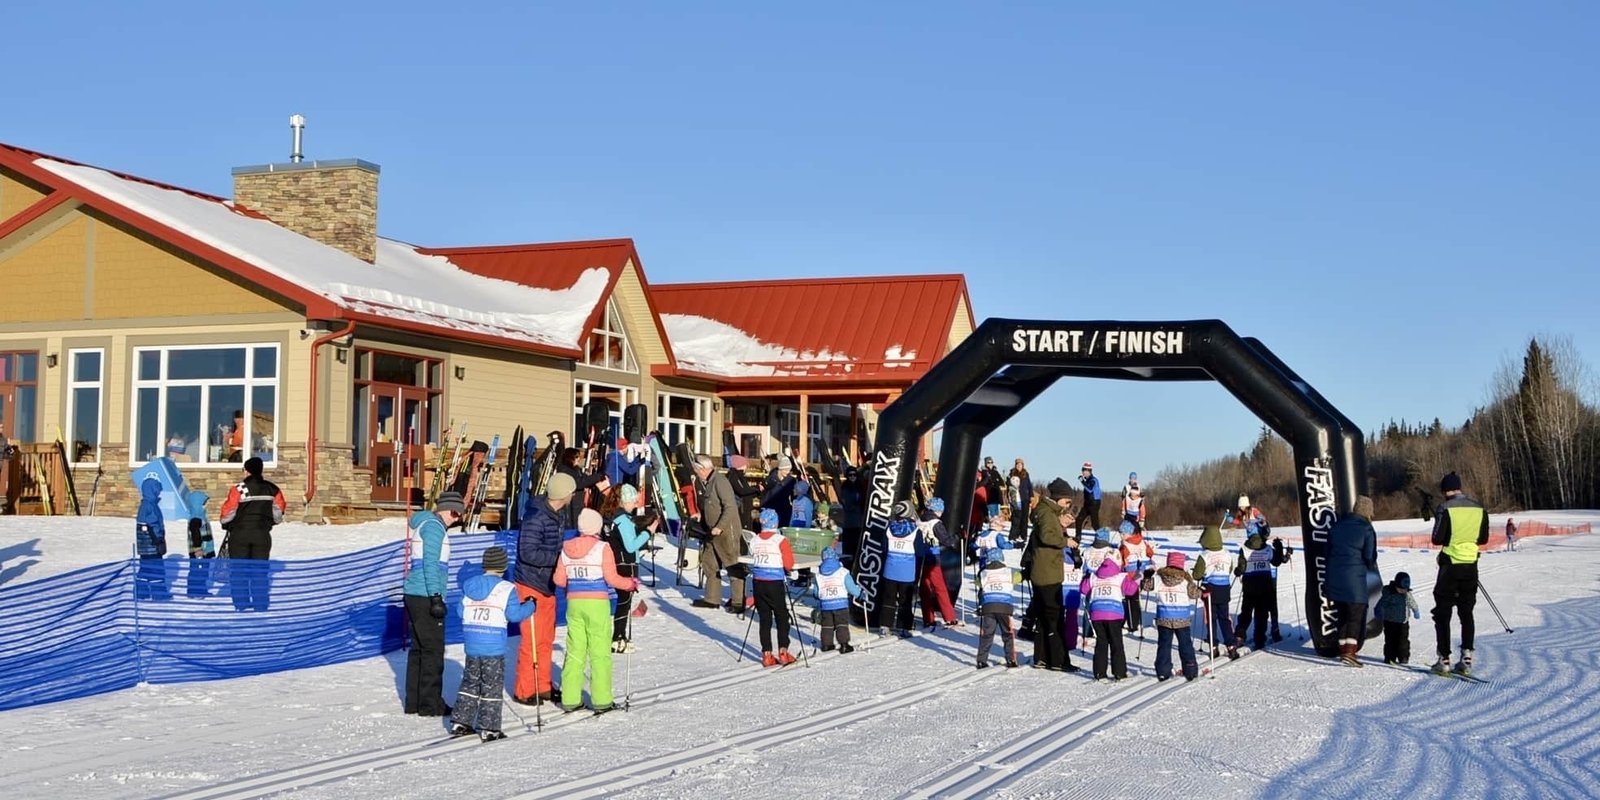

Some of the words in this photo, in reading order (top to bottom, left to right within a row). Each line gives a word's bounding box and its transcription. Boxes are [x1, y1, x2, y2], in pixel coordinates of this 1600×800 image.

[1012, 329, 1084, 352] START
[1088, 330, 1099, 355] /
[1105, 331, 1184, 354] FINISH
[866, 450, 900, 530] TRAX
[893, 541, 906, 550] 167
[756, 553, 769, 565] 172
[573, 566, 588, 578] 161
[853, 531, 882, 612] FAST
[1066, 573, 1079, 582] 152
[990, 582, 1004, 592] 155
[1098, 586, 1112, 596] 153
[1165, 592, 1177, 603] 151
[472, 607, 490, 621] 173
